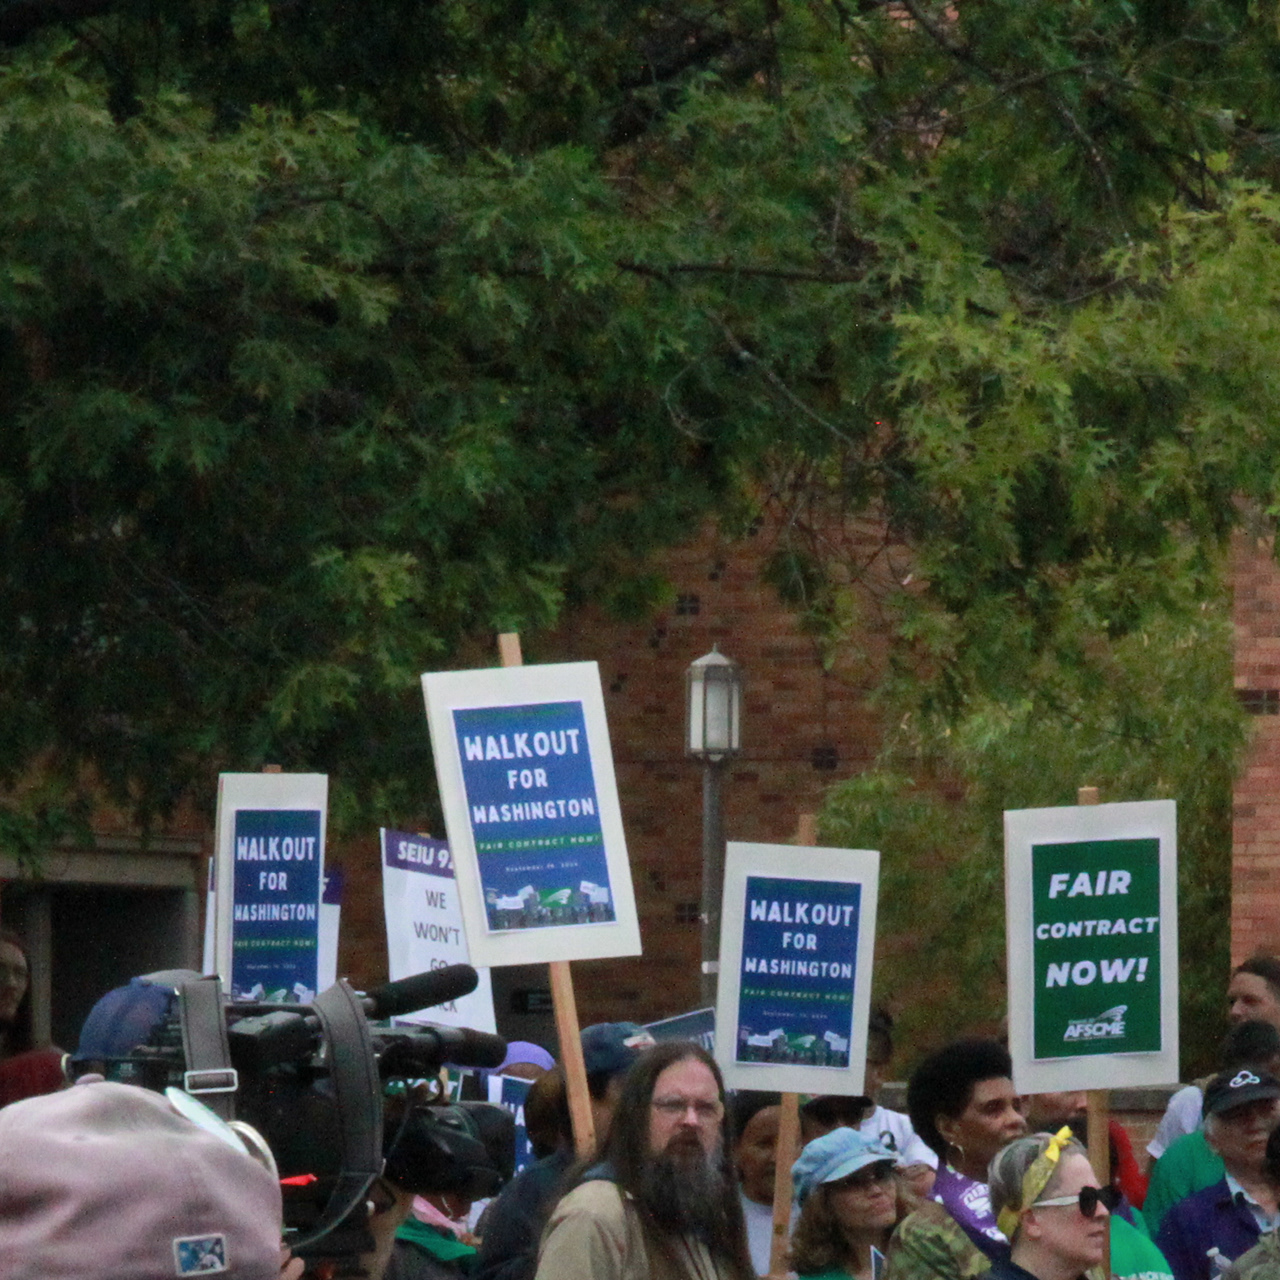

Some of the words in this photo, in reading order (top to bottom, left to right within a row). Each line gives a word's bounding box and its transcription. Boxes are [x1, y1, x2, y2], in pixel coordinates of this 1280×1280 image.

[464, 729, 581, 761] WALKOUT
[507, 768, 549, 790] FOR
[473, 797, 595, 824] WASHINGTON
[237, 836, 316, 861] WALKOUT
[397, 841, 434, 866] SEIU
[259, 871, 288, 891] FOR
[1048, 870, 1132, 899] FAIR
[425, 889, 447, 910] WE
[234, 903, 316, 921] WASHINGTON
[750, 900, 854, 926] WALKOUT
[413, 921, 460, 946] WON'T
[1036, 917, 1159, 940] CONTRACT
[782, 932, 817, 950] FOR
[745, 957, 852, 979] WASHINGTON
[1045, 957, 1149, 988] NOW!
[1063, 1021, 1126, 1038] AFSCME
